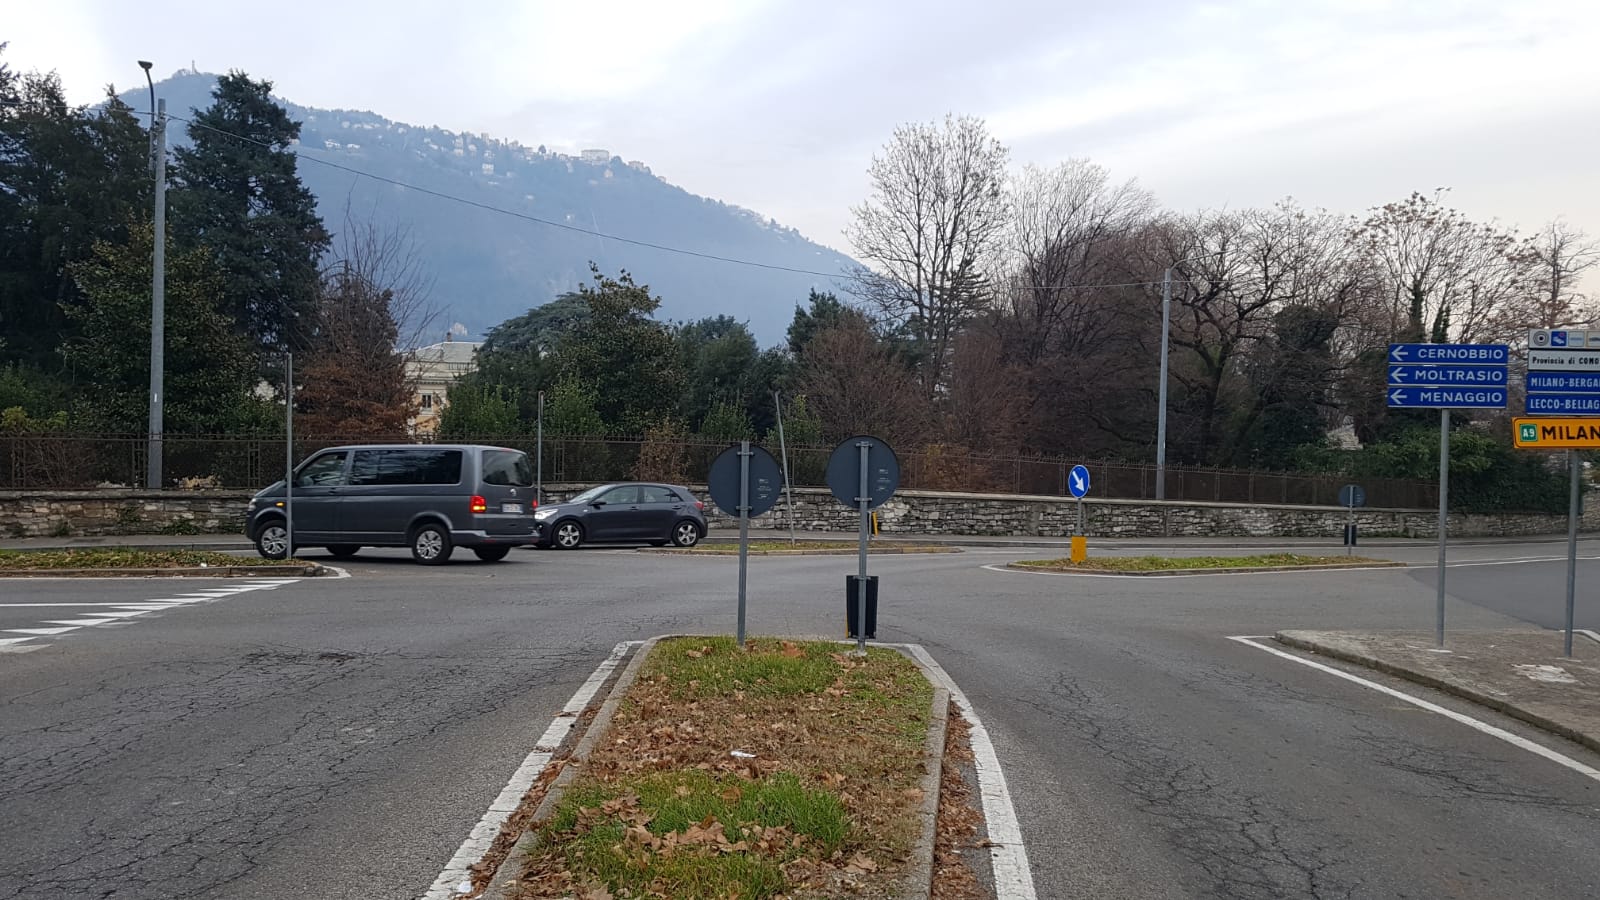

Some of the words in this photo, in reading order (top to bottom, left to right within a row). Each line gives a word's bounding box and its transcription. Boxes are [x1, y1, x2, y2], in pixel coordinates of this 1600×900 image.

[1418, 348, 1504, 359] CERNOBBIO
[1532, 356, 1565, 365] Provincia
[1568, 356, 1575, 365] di
[1578, 357, 1599, 365] COMO
[1415, 370, 1503, 381] MOLTRASIO
[1531, 377, 1600, 388] MILANO-BERGA
[1420, 392, 1503, 403] MENAGGIO
[1530, 398, 1600, 410] LECCO-BELLAG
[1522, 428, 1535, 438] A9
[1541, 425, 1600, 440] MILAN
